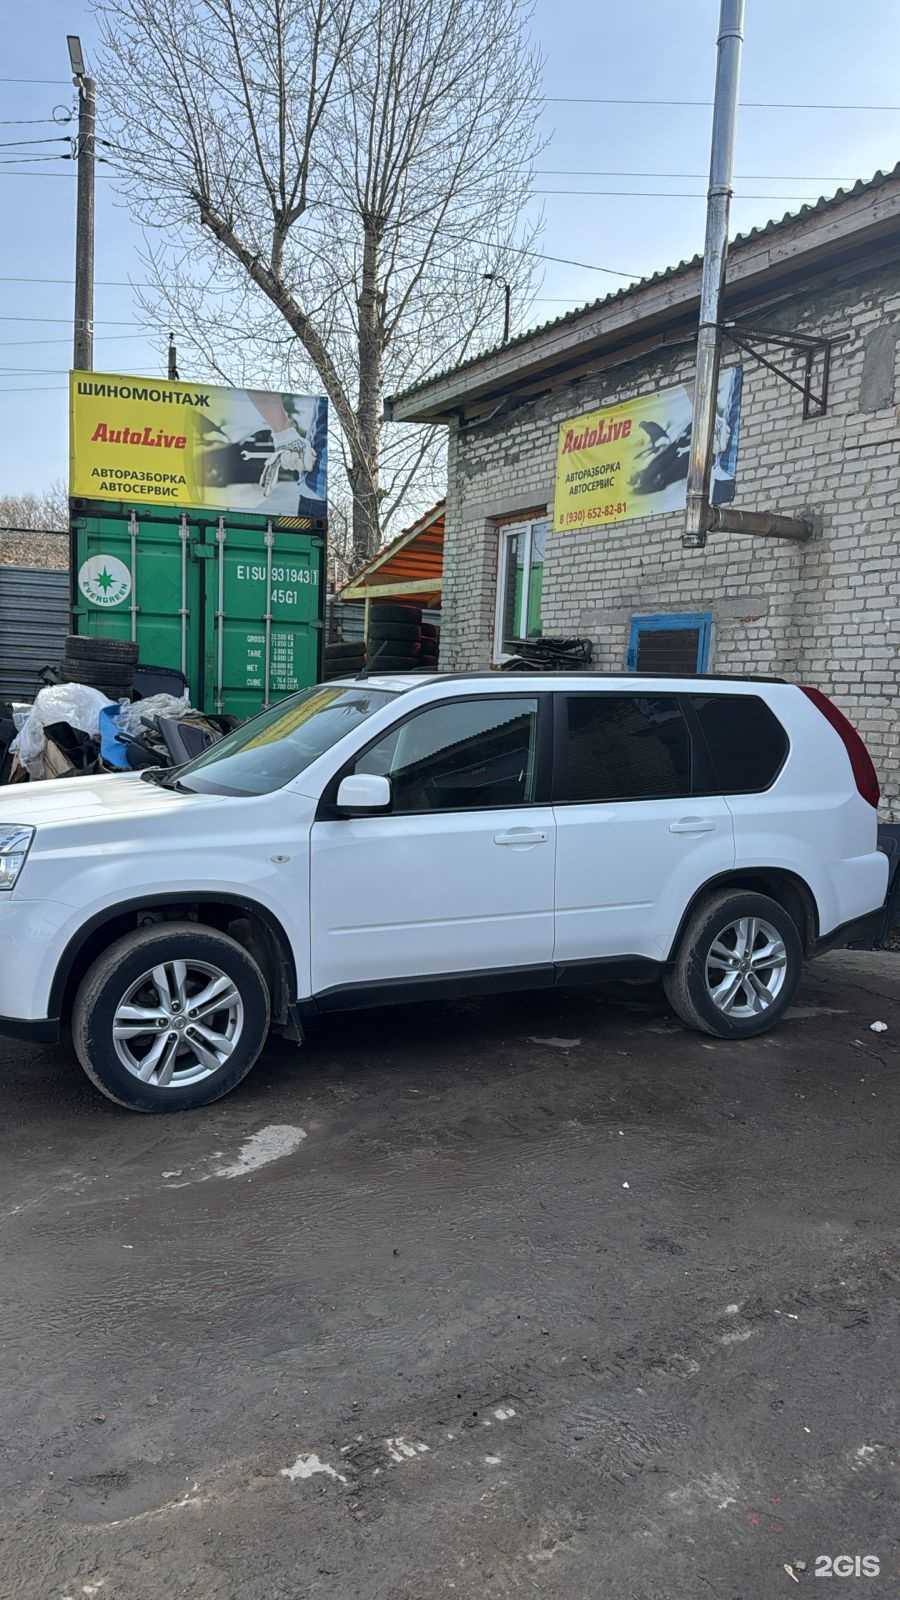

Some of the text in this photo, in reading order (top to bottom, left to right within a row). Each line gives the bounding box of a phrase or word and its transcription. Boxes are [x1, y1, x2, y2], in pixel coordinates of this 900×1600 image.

[77, 382, 211, 407] ШИНОМОНТАЖ
[91, 422, 187, 449] AutoLive
[562, 418, 632, 455] AutoLive
[91, 467, 186, 485] АВТОРАЗБОРКА
[565, 461, 621, 483] АВТОРАЗБОРКА
[99, 481, 179, 497] АВТОСЕРВИС
[569, 476, 615, 496] АВТОСЕРВИС
[560, 514, 564, 525] 8
[566, 509, 585, 526] (930)
[237, 565, 266, 581] EISU
[83, 580, 128, 603] EVERGREEN
[271, 589, 298, 605] 45G1
